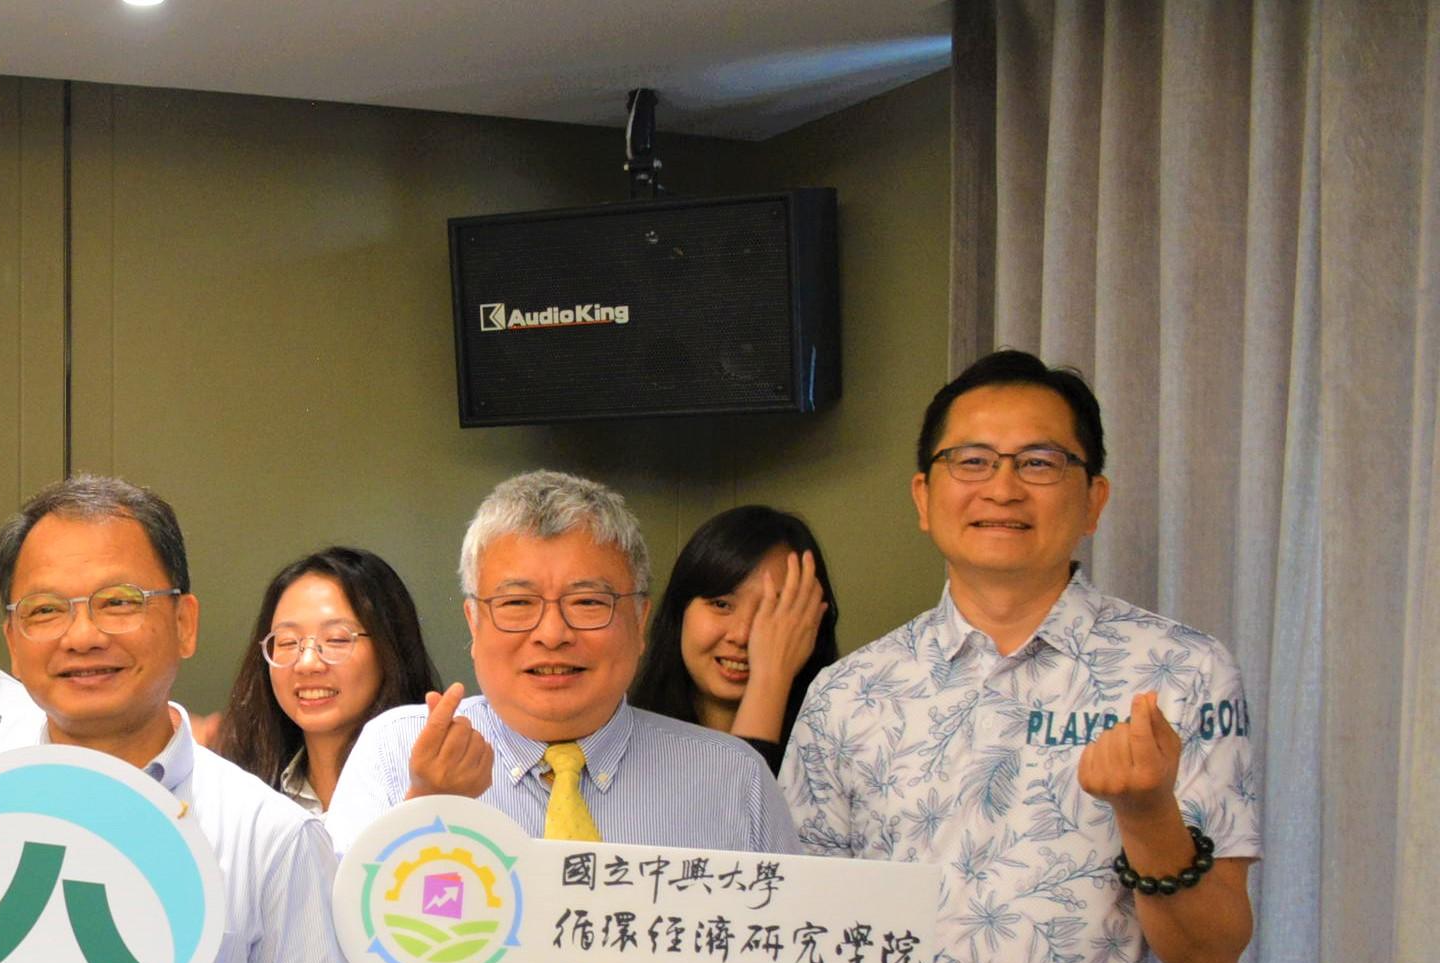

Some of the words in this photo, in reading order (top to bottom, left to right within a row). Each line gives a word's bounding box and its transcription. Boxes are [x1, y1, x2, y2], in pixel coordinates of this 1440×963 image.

[507, 304, 630, 328] AudioKing
[1026, 709, 1131, 746] PLAY
[561, 852, 786, 910] 國立中興大學
